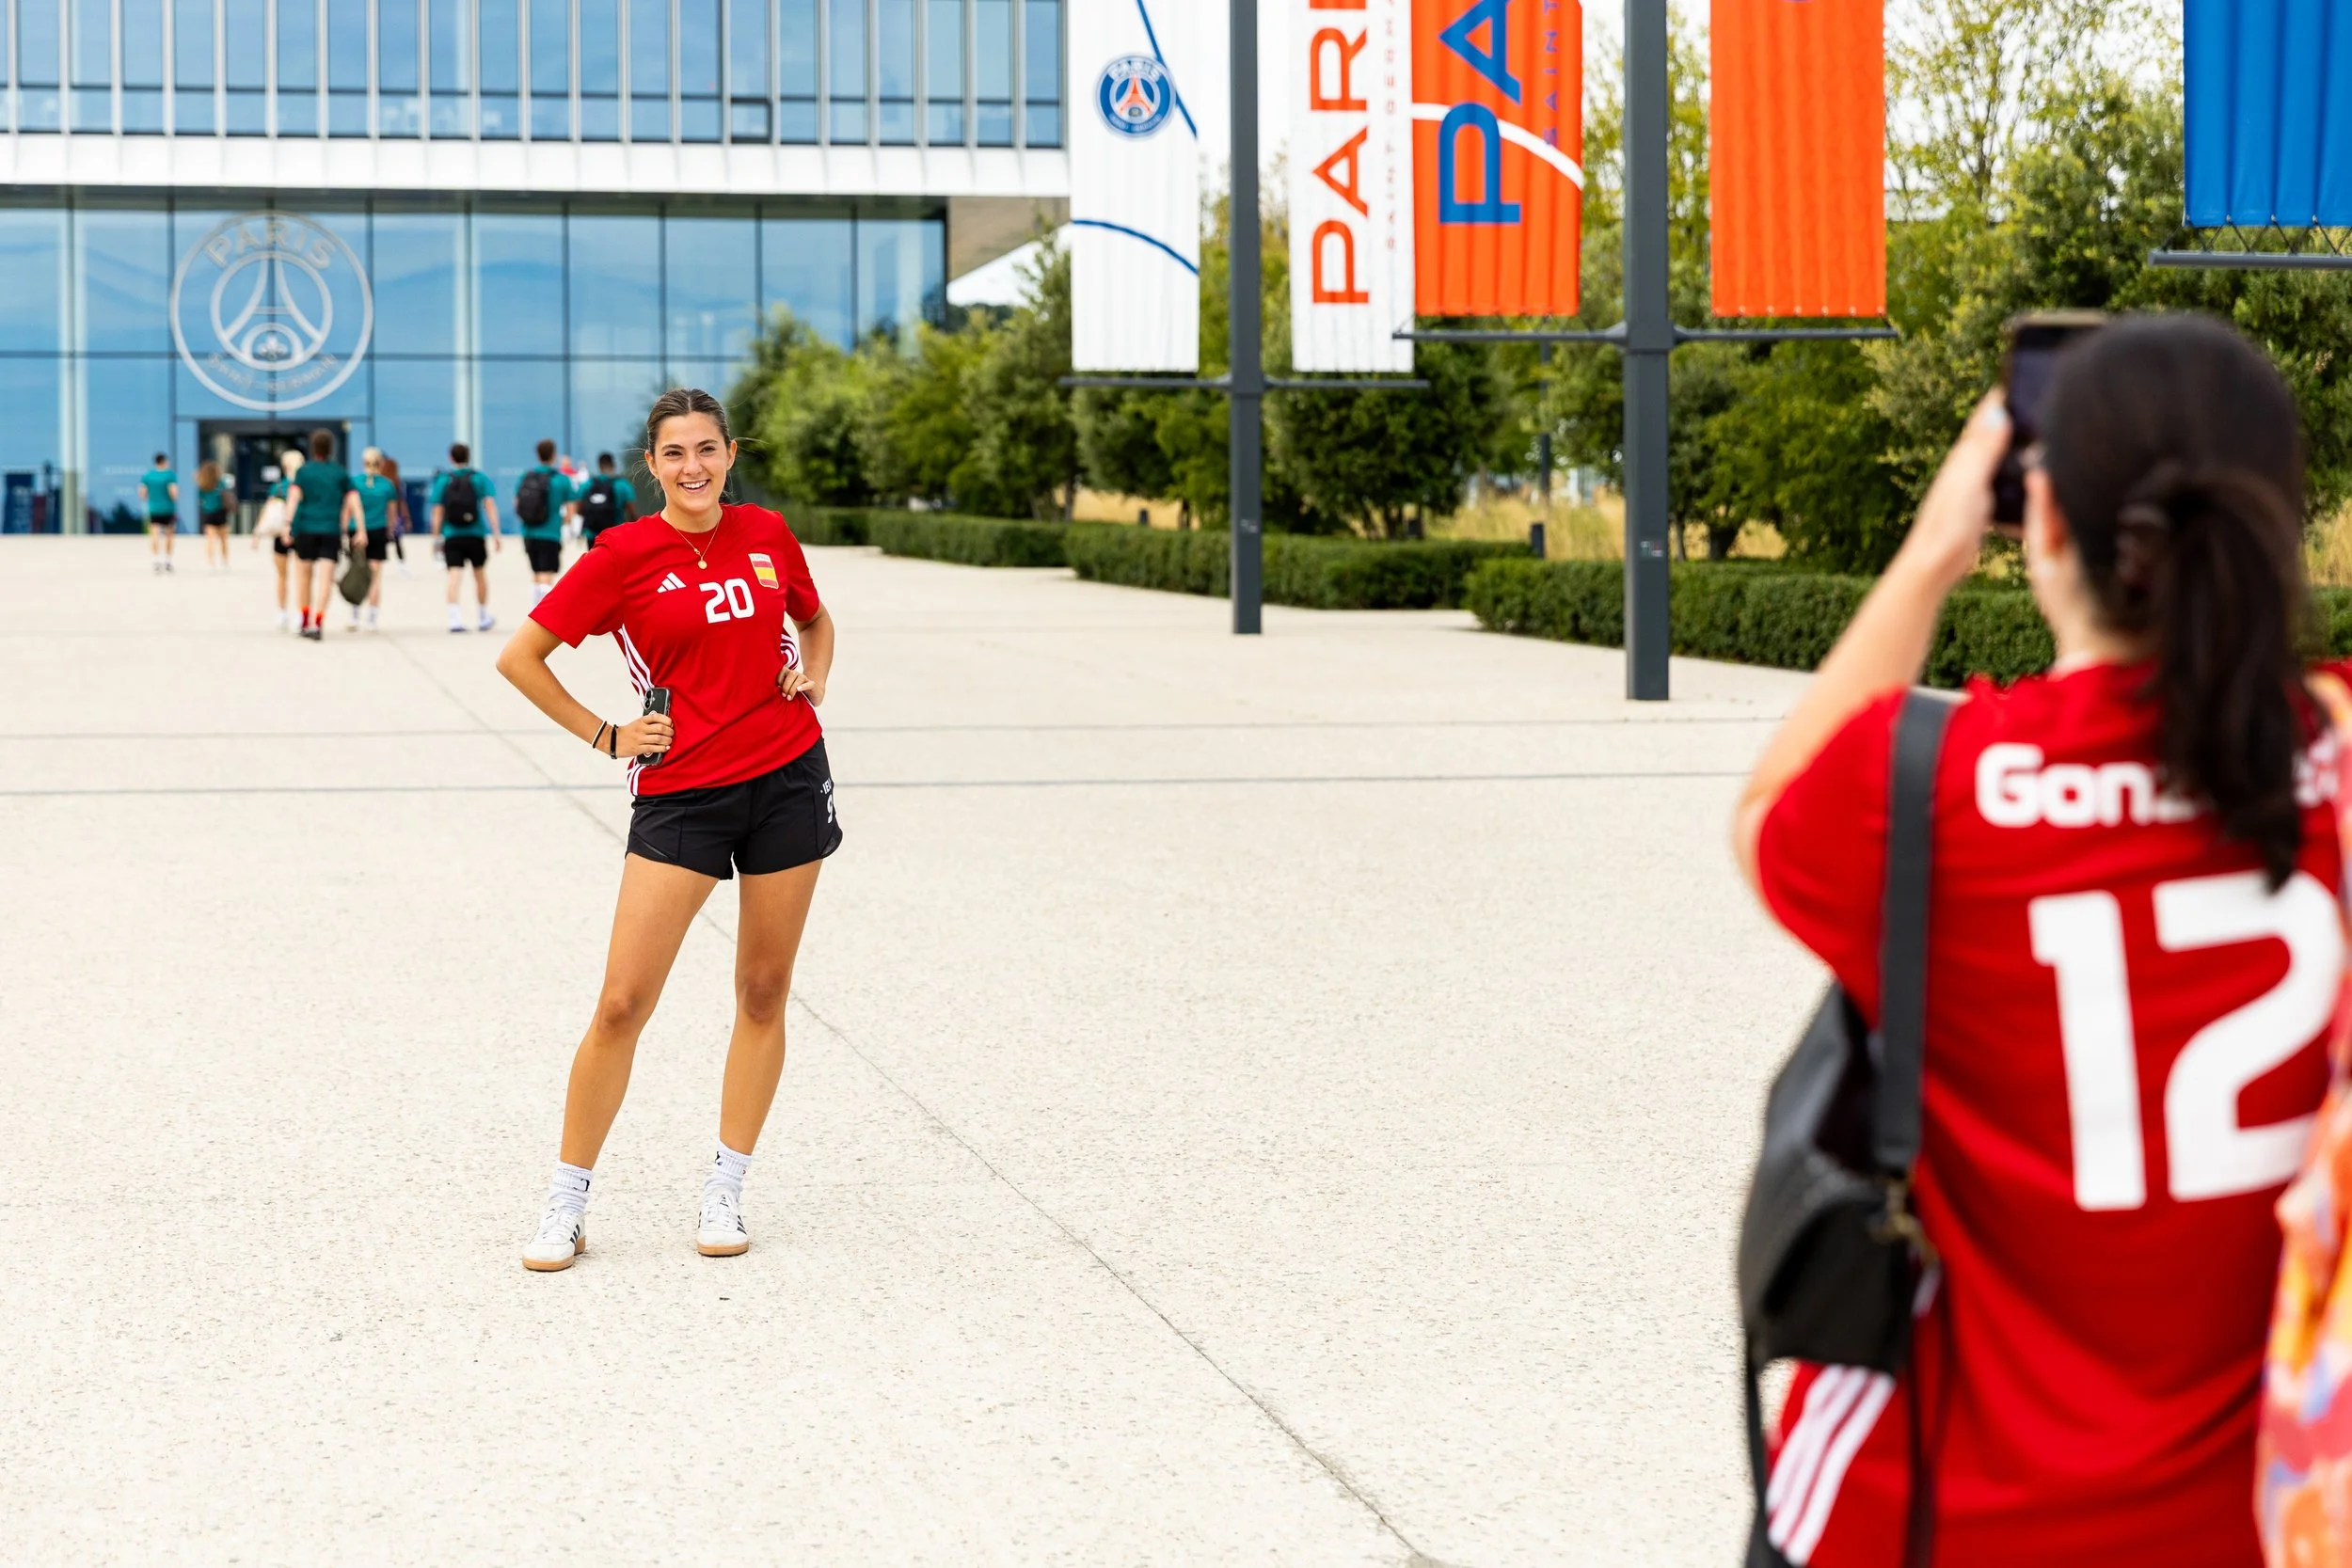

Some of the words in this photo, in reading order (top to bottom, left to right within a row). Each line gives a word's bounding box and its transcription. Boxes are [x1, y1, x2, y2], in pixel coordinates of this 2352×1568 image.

[204, 220, 336, 269] PARIS
[699, 578, 755, 624] 20
[2028, 869, 2344, 1212] 12
